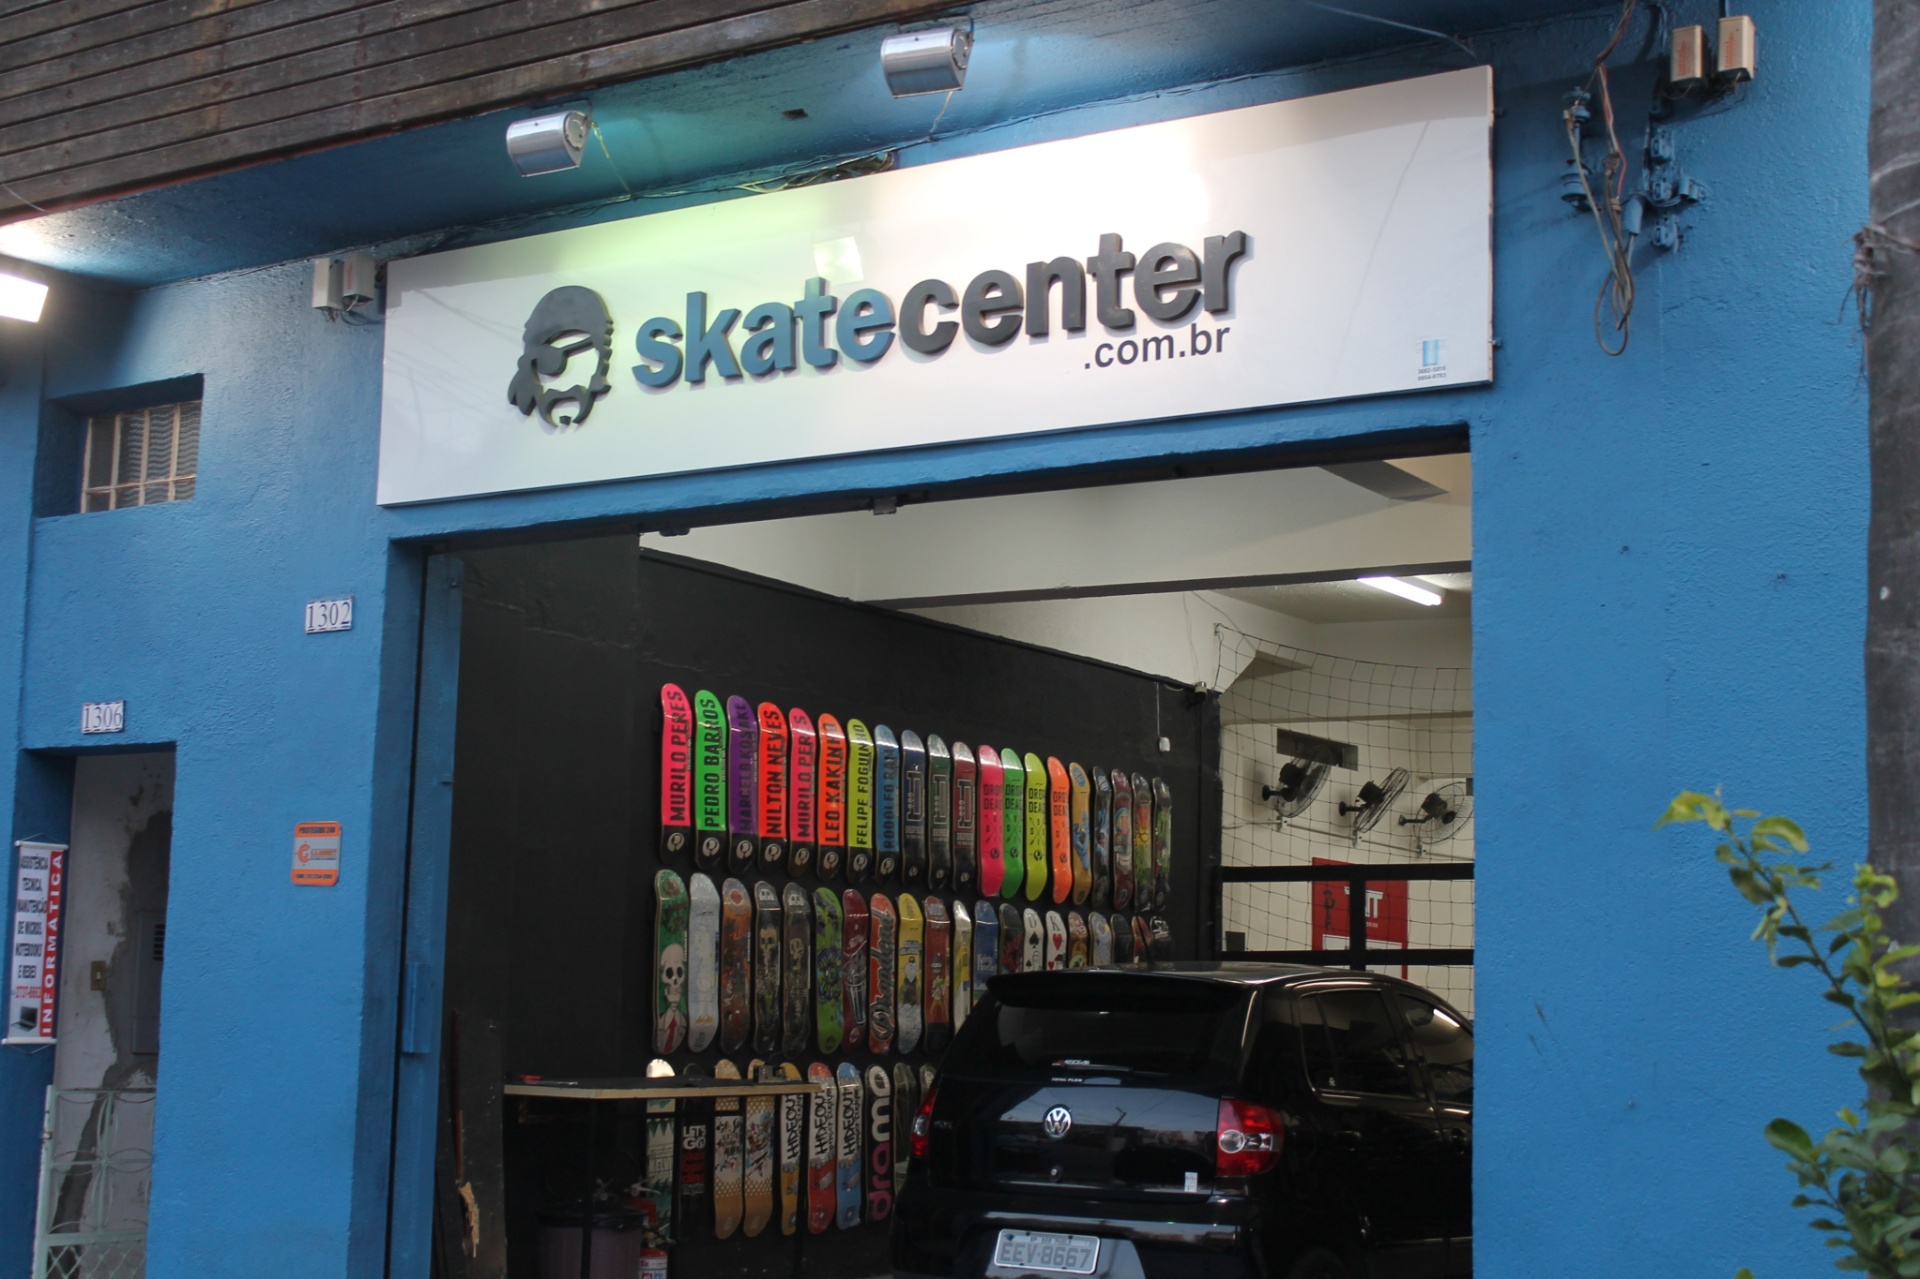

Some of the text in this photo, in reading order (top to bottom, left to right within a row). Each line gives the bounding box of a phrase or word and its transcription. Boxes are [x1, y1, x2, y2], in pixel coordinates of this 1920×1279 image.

[631, 230, 1247, 388] skatecenter
[1084, 323, 1230, 369] .com.br
[307, 601, 351, 629] 1302
[83, 703, 123, 729] 1306
[667, 690, 687, 822] MURILO PERES
[700, 698, 720, 828] PEDRO BARROS
[763, 710, 783, 834] NILTON NEVES
[797, 772, 811, 837] MURILO
[825, 810, 841, 842] LEO
[855, 798, 869, 845] FELIPE
[41, 854, 63, 1034] INFORMATICA
[785, 1094, 799, 1160] HIDEOU
[814, 1093, 828, 1155] HIDEOU
